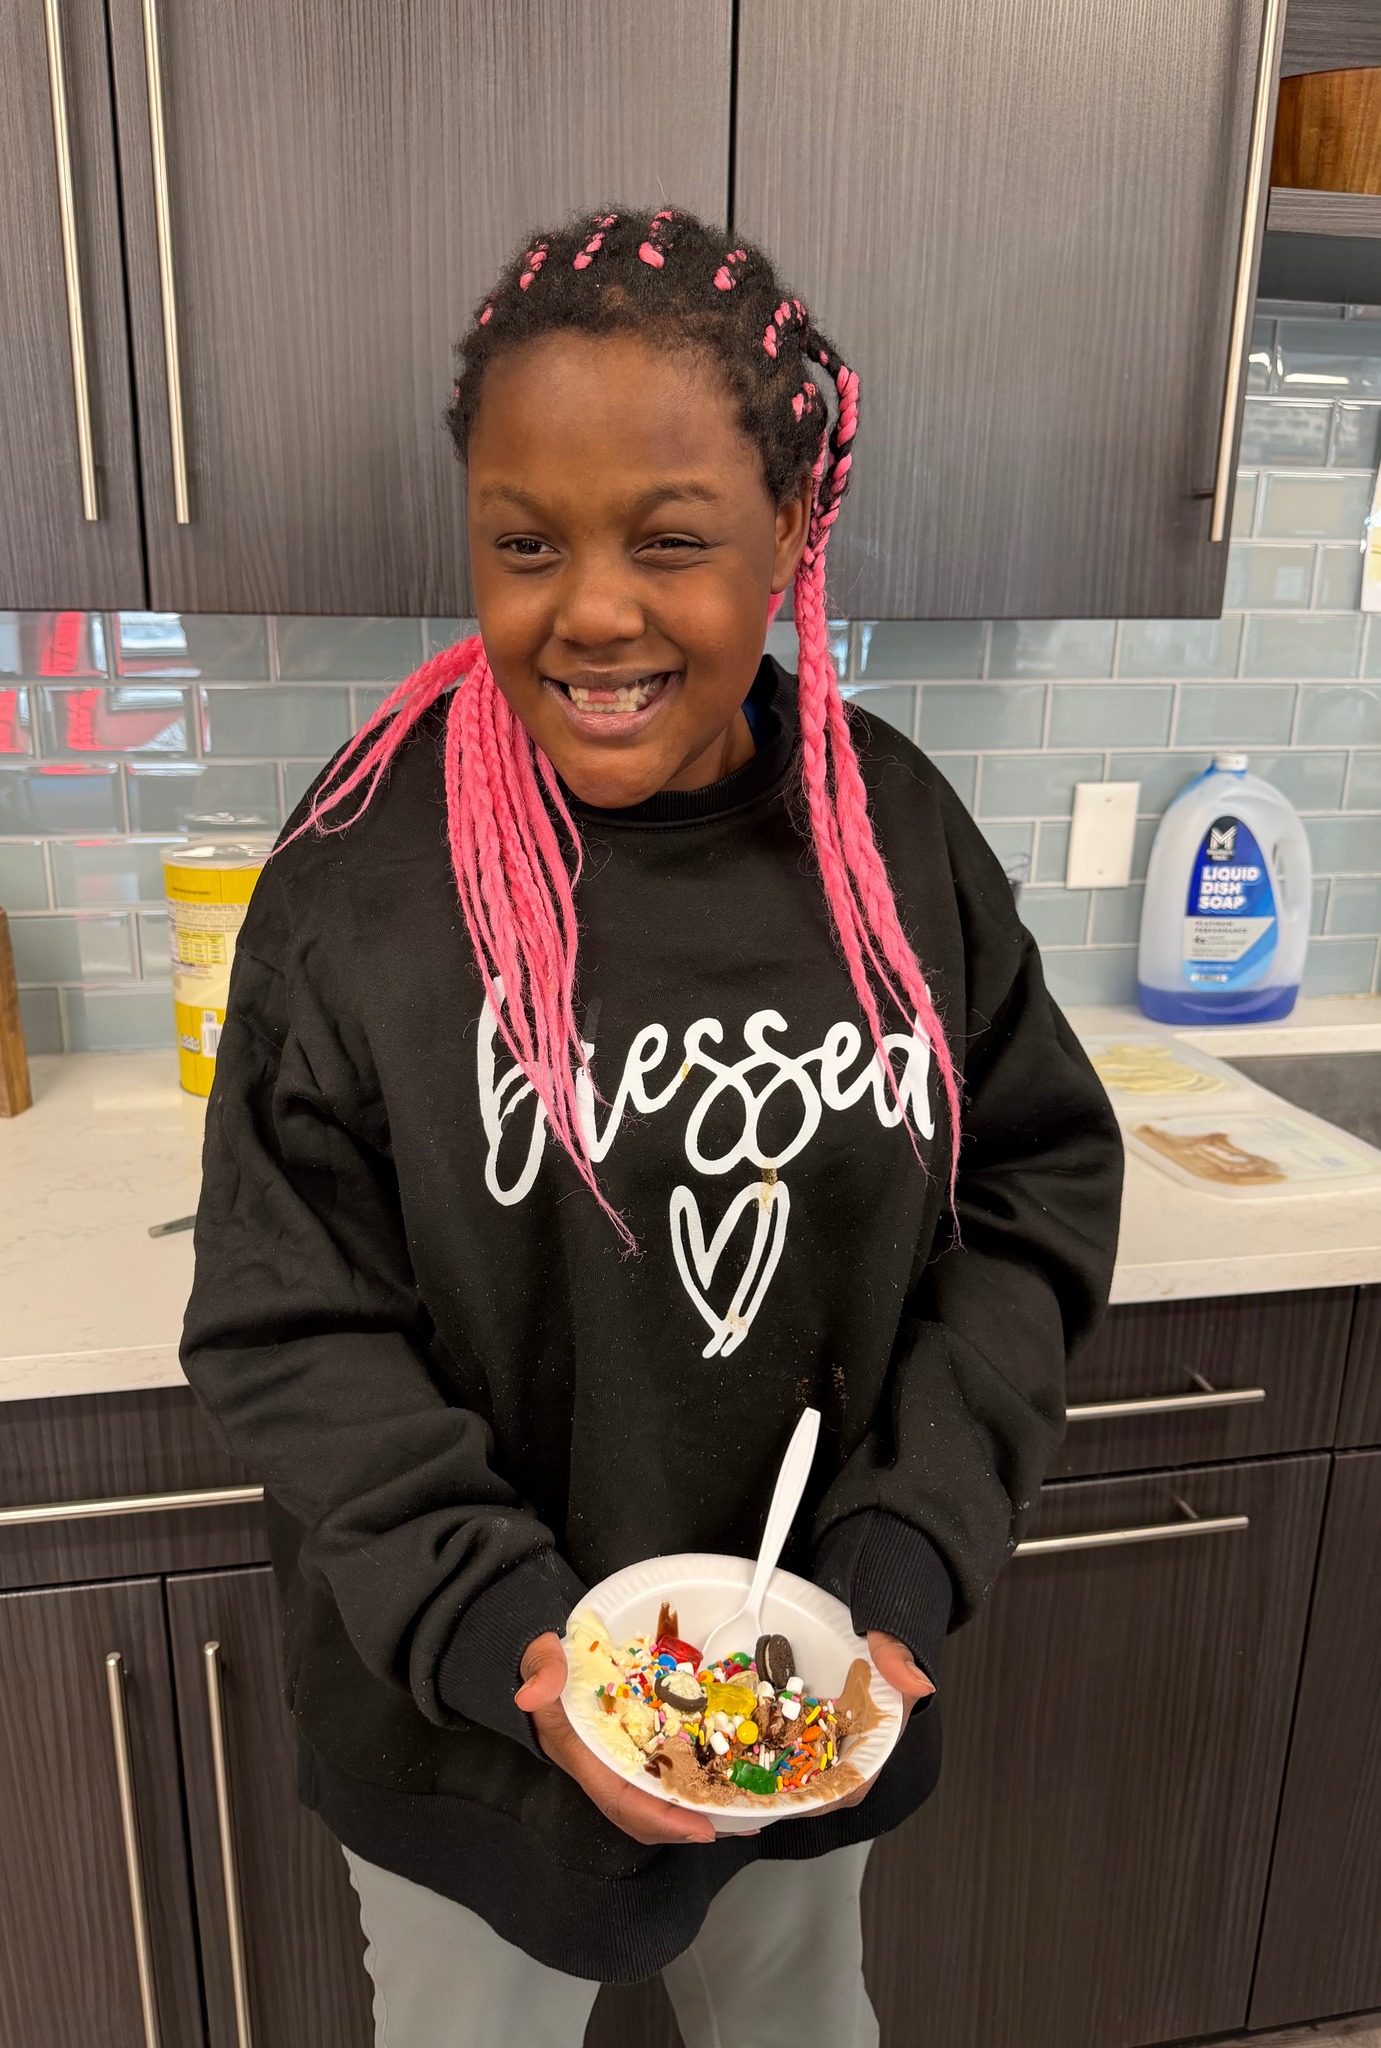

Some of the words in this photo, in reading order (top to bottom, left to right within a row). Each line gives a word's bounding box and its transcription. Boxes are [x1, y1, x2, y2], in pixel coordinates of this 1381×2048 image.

[1202, 866, 1260, 881] LIQUID
[1200, 881, 1241, 896] DISH
[1198, 895, 1246, 910] SOAP
